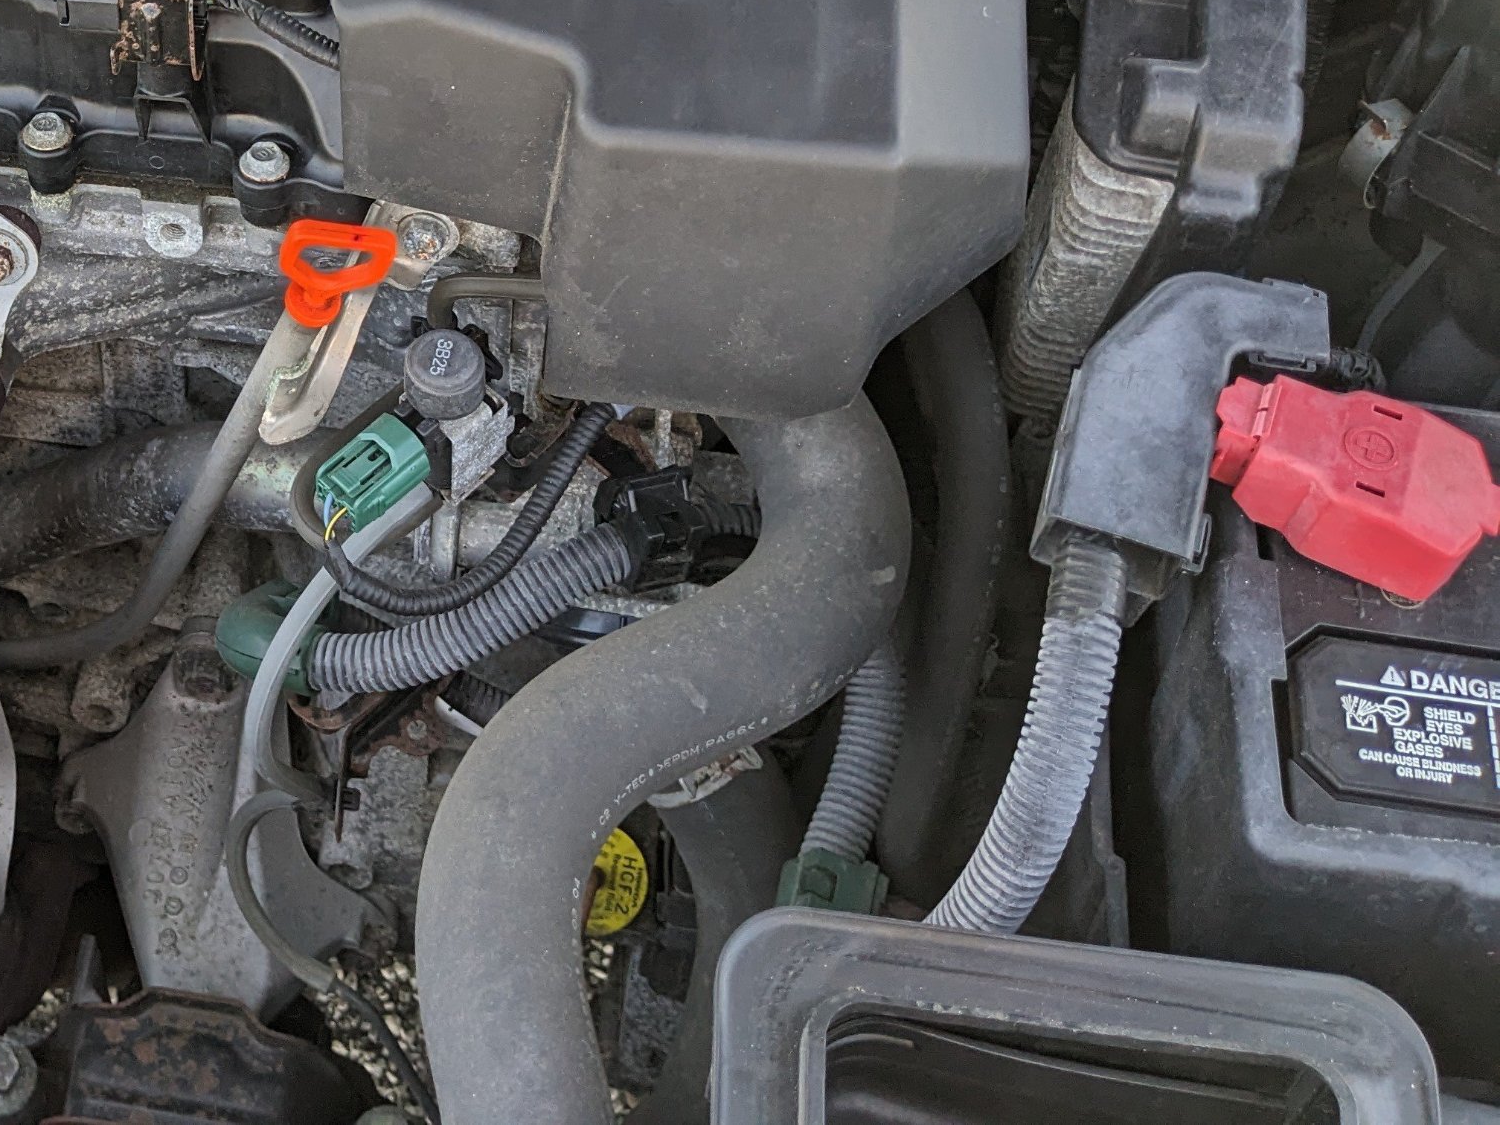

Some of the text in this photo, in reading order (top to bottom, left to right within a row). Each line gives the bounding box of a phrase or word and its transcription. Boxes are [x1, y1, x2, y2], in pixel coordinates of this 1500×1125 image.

[429, 338, 454, 376] 3B25
[1423, 706, 1477, 725] SHIELD
[1425, 720, 1465, 736] EYES
[1392, 728, 1474, 751] EXPLOSIVE
[1394, 740, 1445, 759] GASES
[1358, 748, 1483, 777] CAN CAUSE BLINDNESS
[1396, 766, 1454, 784] OR INJURY
[615, 855, 639, 916] HCF-2
